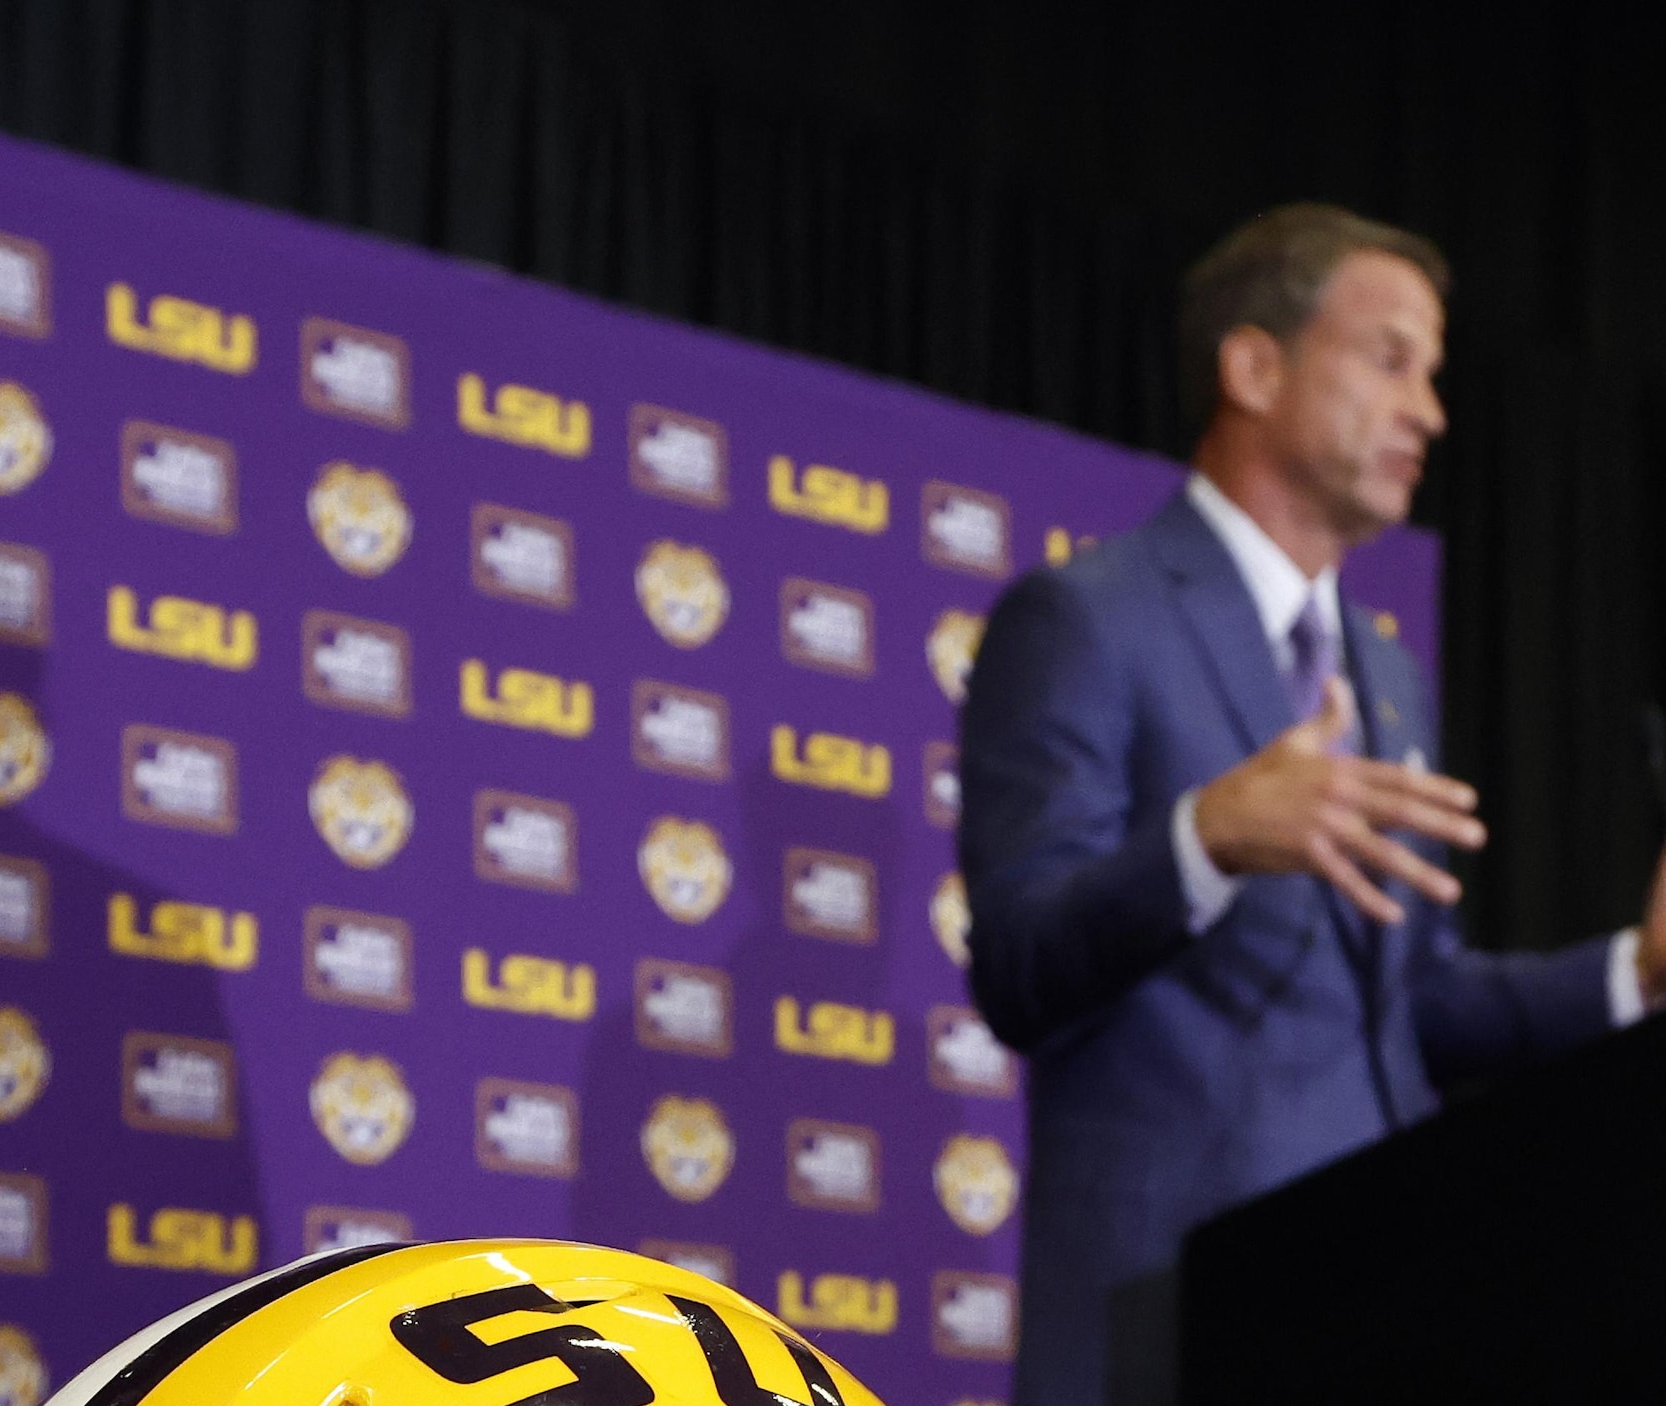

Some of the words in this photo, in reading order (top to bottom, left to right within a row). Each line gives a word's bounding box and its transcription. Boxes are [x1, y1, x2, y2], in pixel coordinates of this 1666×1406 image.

[108, 284, 255, 372] LSU
[460, 376, 590, 456] LSU
[770, 458, 888, 531] LSU
[109, 588, 255, 669] LSU
[462, 661, 592, 736] LSU
[773, 727, 891, 797] LSU
[109, 894, 256, 969] LSU
[464, 949, 595, 1020] LSU
[776, 997, 895, 1064] LSU
[108, 1204, 257, 1275] LSU
[778, 1271, 898, 1334] LSU
